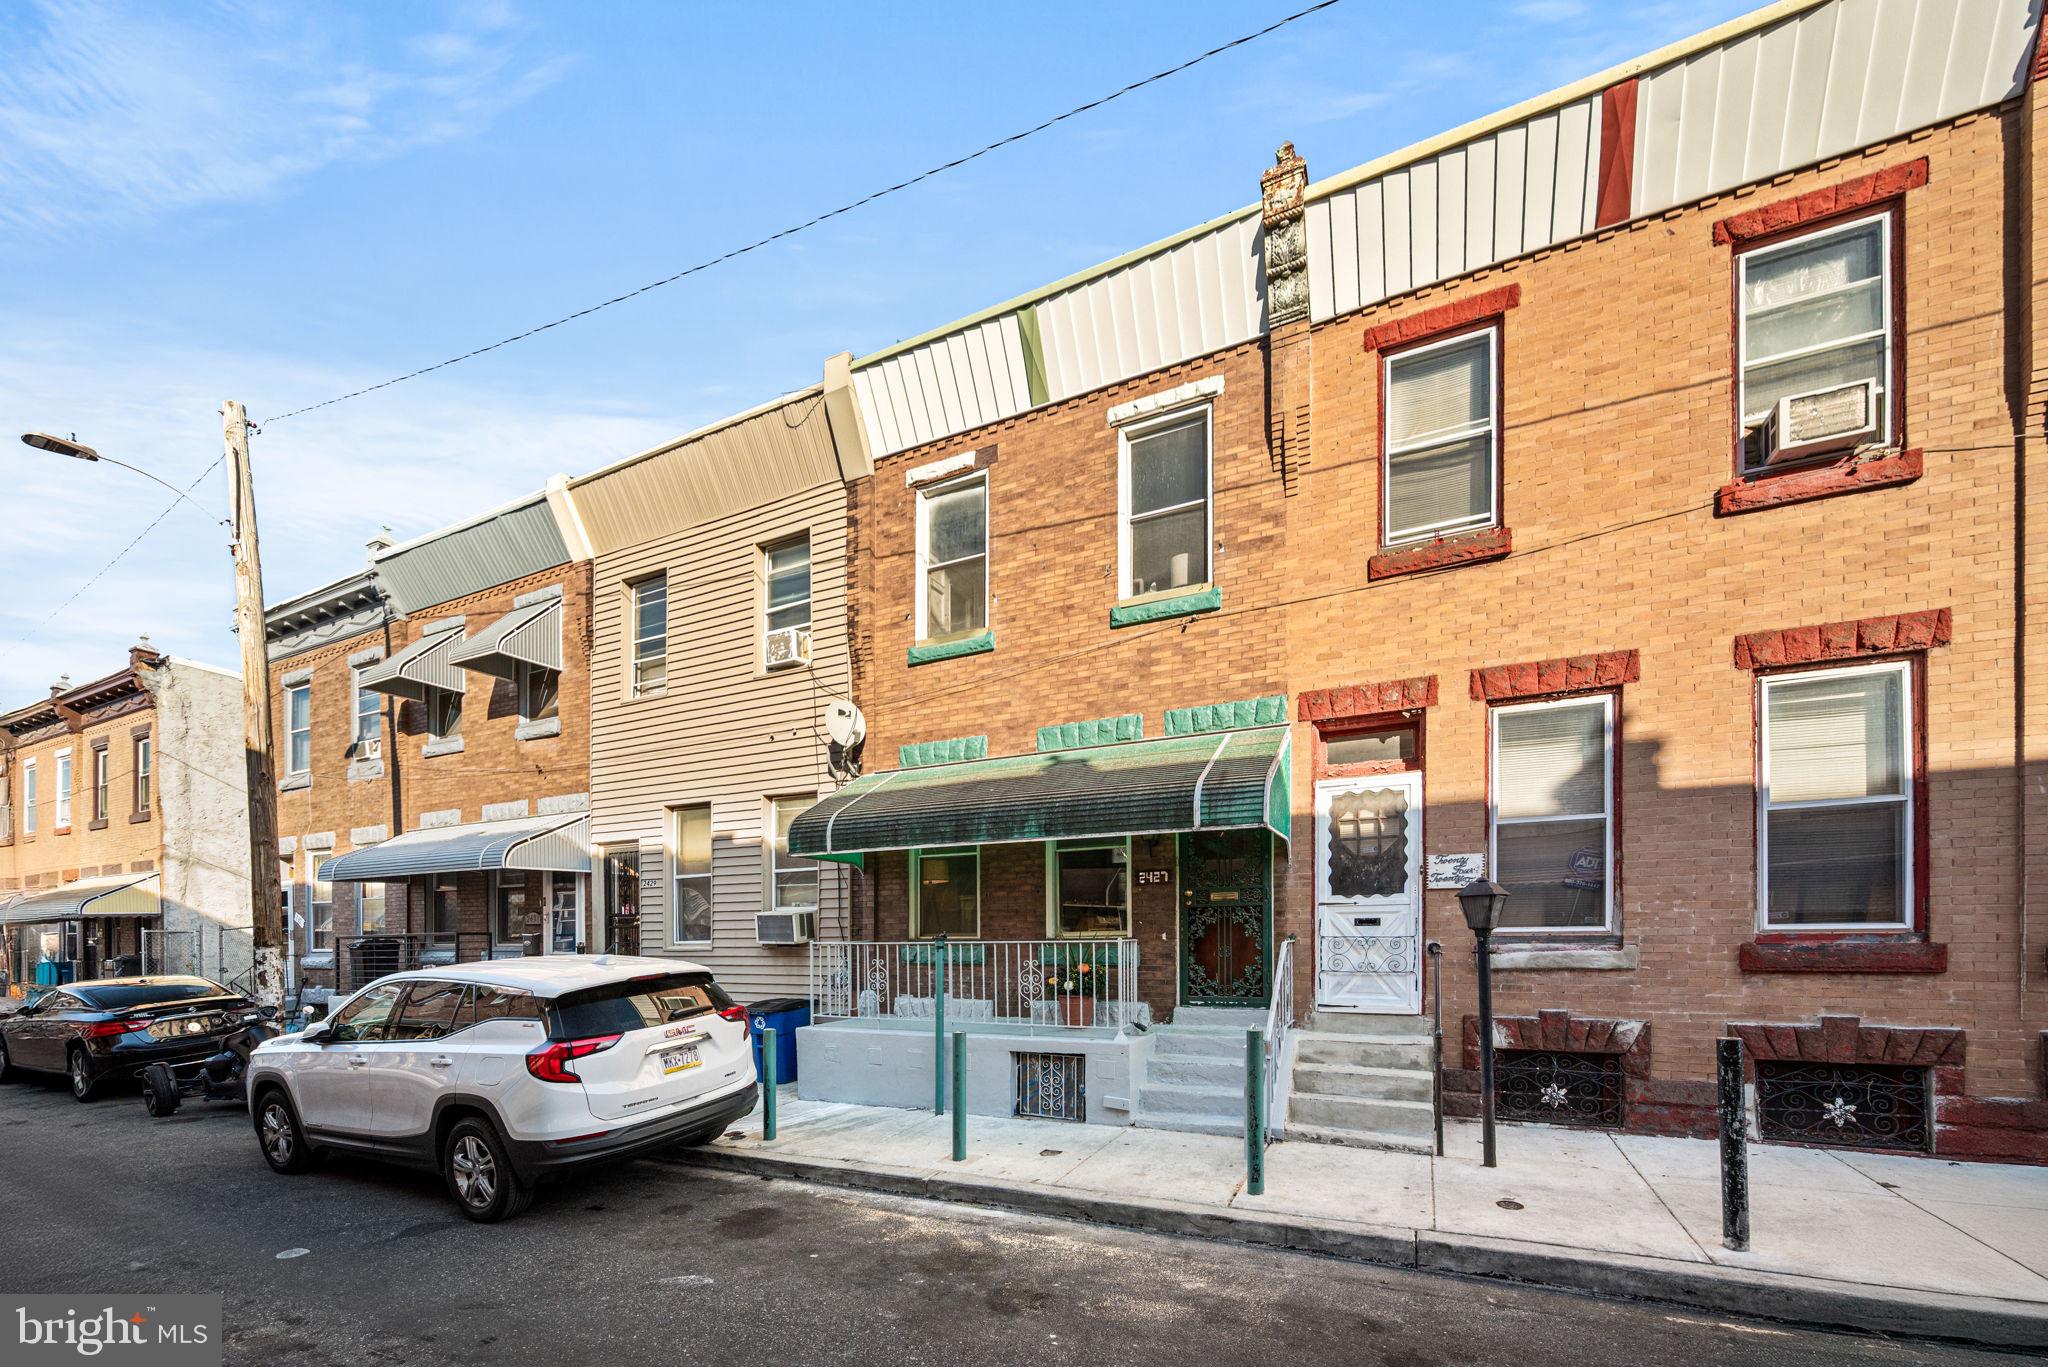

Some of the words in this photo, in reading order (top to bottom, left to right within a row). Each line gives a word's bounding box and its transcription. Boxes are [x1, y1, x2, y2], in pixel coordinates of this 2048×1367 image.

[1434, 855, 1469, 867] Twenty
[1575, 857, 1600, 869] ADT
[1139, 871, 1168, 884] 2427
[1430, 873, 1464, 884] Twenty
[664, 1024, 696, 1038] GMC
